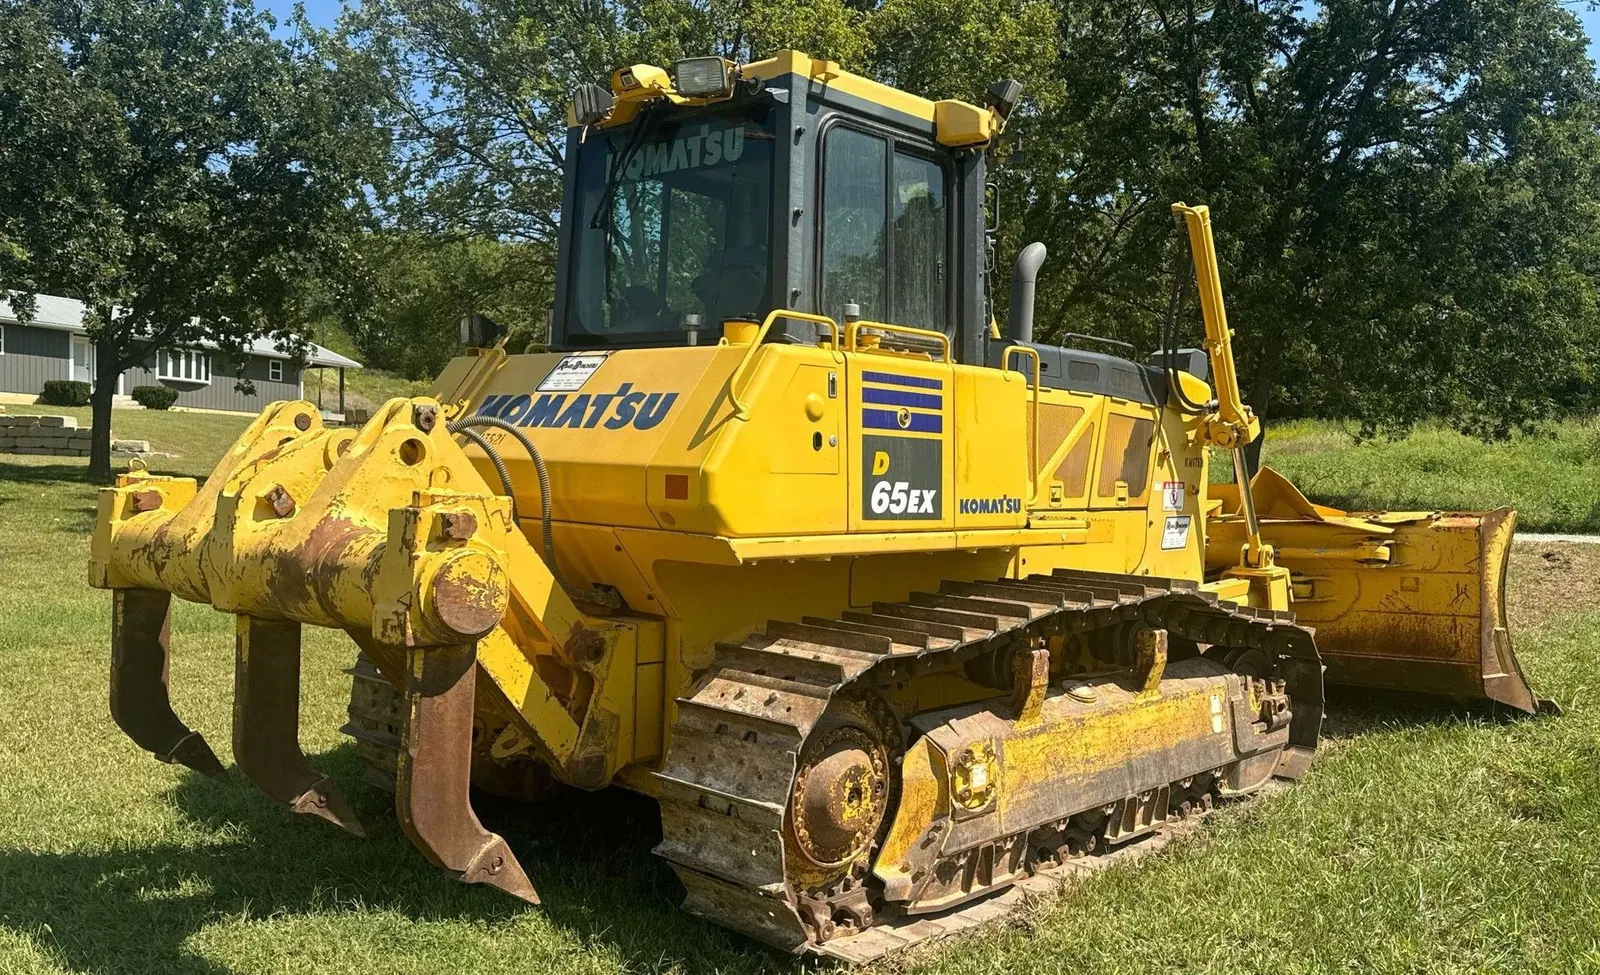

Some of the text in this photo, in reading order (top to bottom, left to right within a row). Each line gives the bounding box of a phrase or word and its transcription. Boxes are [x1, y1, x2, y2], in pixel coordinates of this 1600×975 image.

[475, 383, 679, 431] KOMATSU
[872, 451, 890, 476] D
[871, 481, 937, 514] 65EX
[959, 494, 1021, 514] KOMATSU
